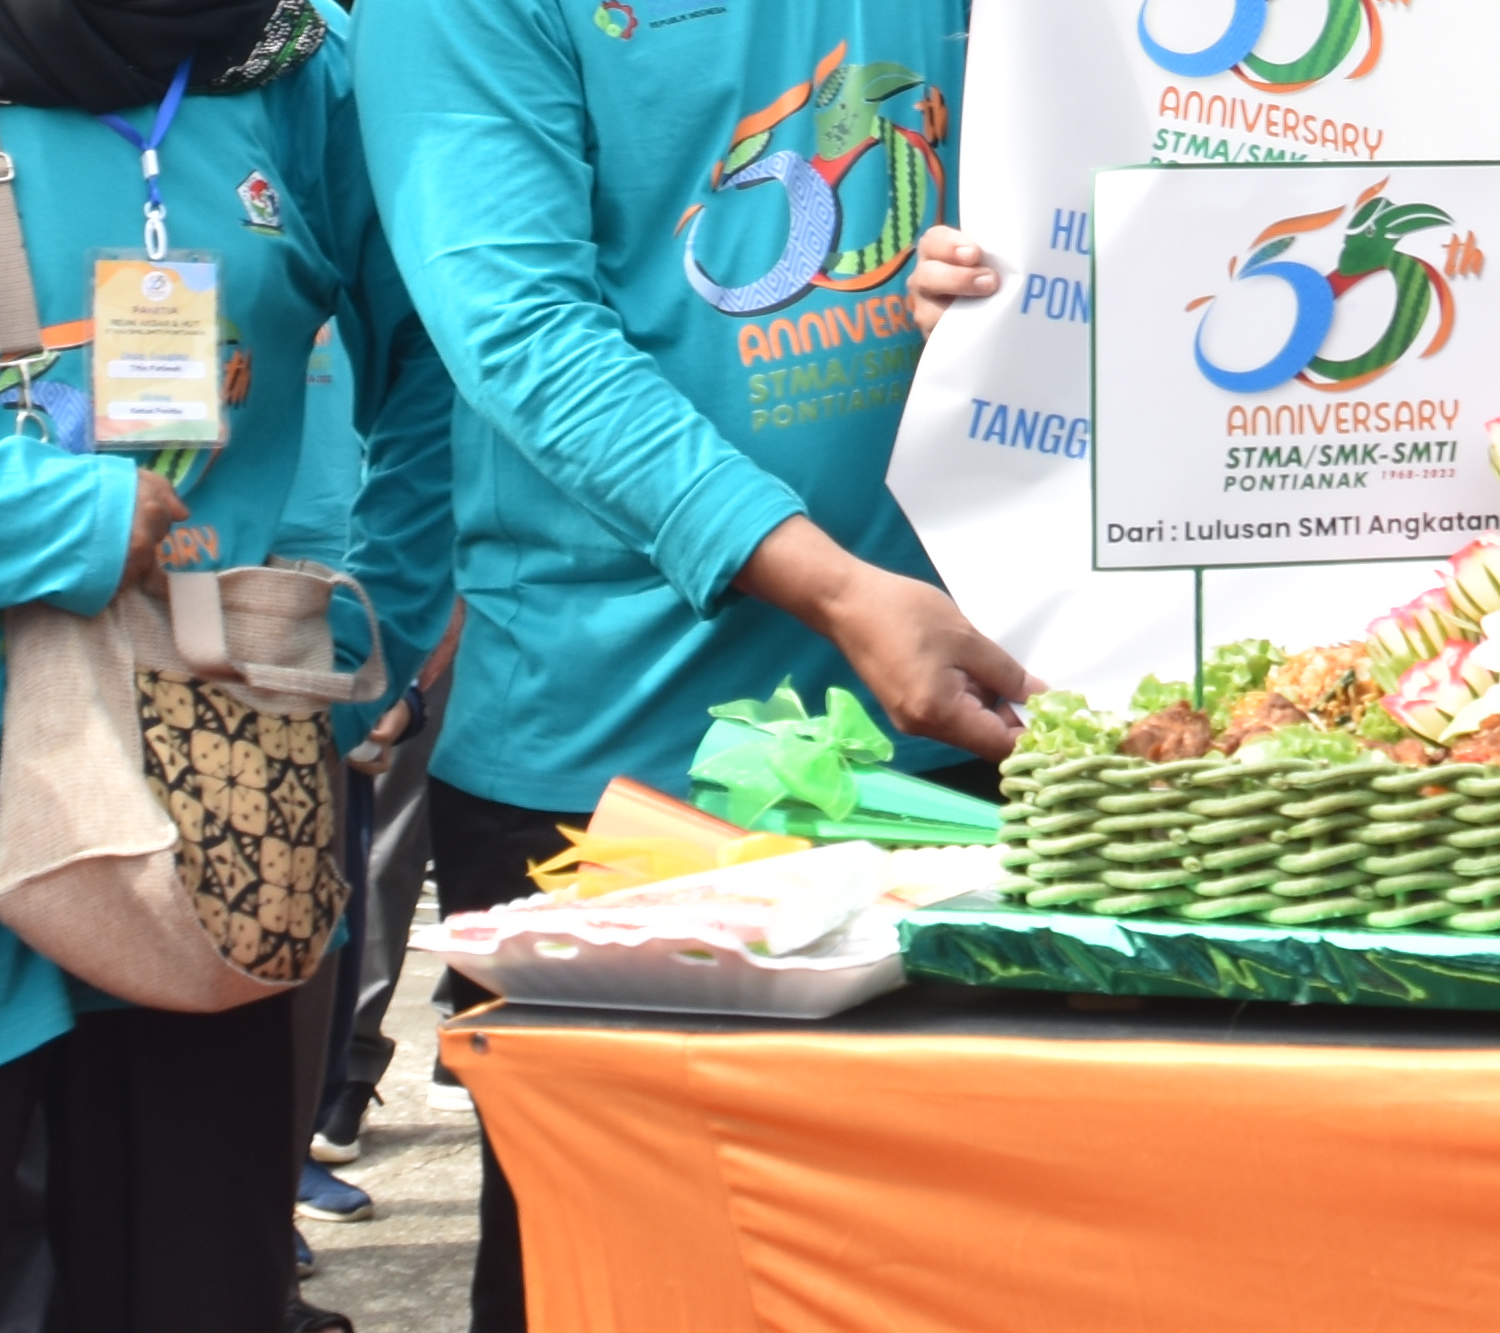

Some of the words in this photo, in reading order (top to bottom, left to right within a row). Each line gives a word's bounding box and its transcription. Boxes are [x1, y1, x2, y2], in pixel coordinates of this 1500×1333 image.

[1159, 85, 1385, 162] ANNIVERSARY
[968, 398, 1089, 460] TANGG
[1225, 399, 1460, 437] ANNIVERSARY
[1223, 440, 1459, 470] STMA/SMK-SMTI
[1222, 470, 1370, 493] PONTIANAK
[1106, 519, 1165, 544] Dari
[1184, 518, 1292, 542] Lulusan
[1298, 514, 1362, 538] SMTI
[1368, 511, 1500, 541] Angkatan
